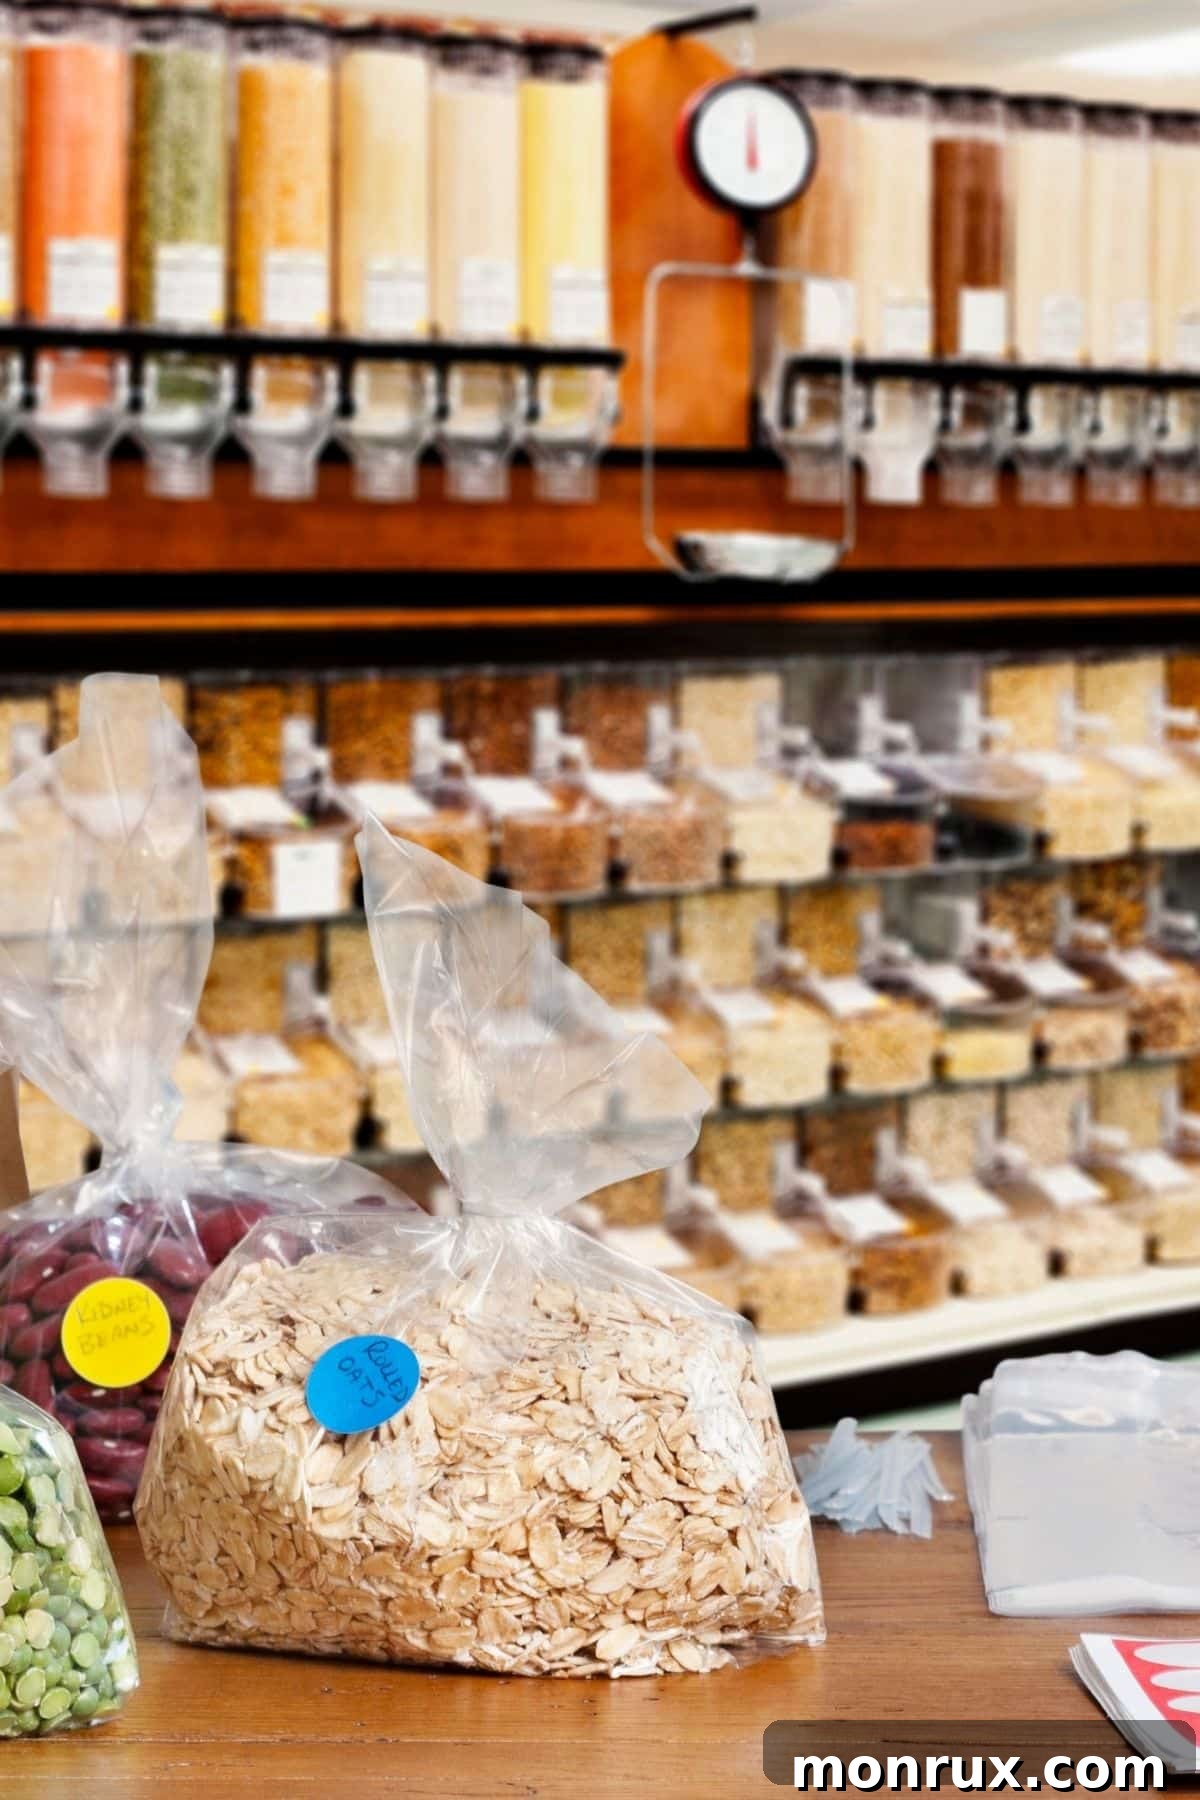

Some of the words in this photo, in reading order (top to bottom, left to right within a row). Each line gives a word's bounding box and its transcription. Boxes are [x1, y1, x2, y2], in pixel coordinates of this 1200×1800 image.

[77, 1292, 150, 1327] KIDNEY
[78, 1316, 154, 1355] BEANS
[338, 1356, 385, 1407] OATS
[363, 1340, 409, 1402] ROLLED
